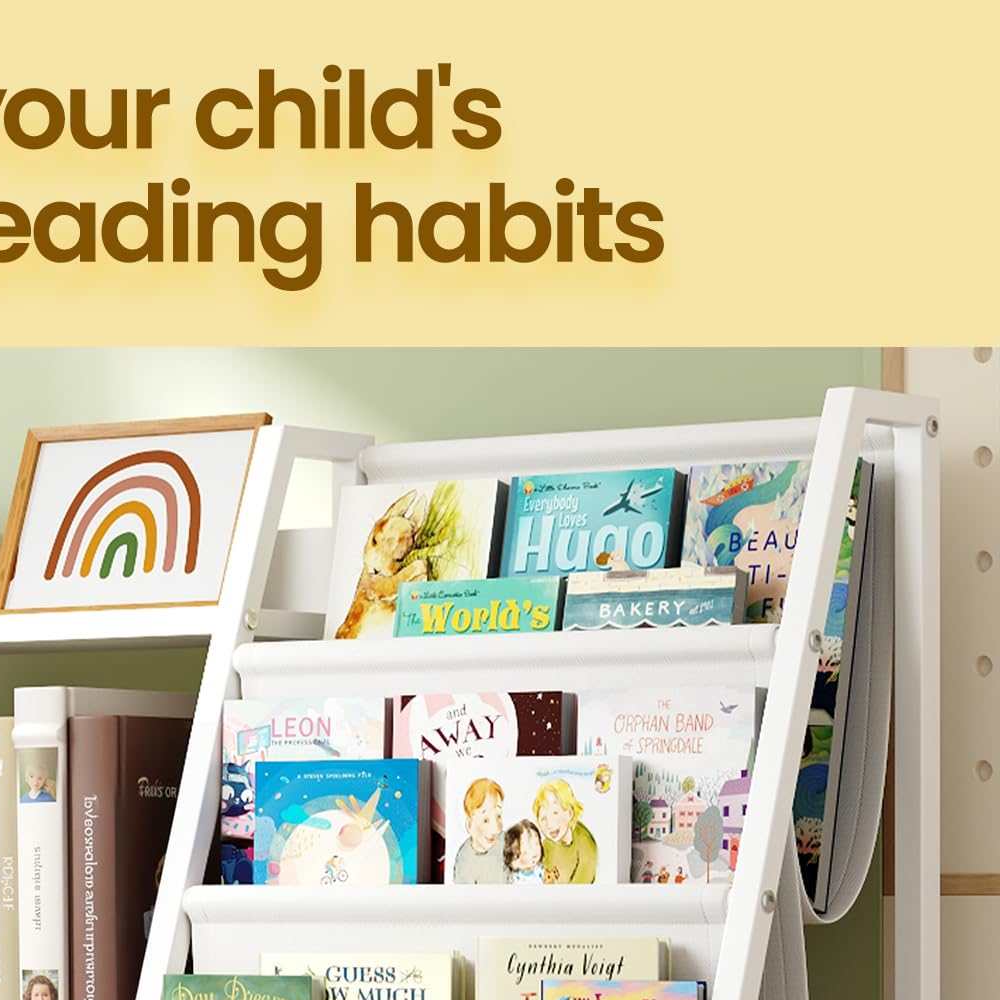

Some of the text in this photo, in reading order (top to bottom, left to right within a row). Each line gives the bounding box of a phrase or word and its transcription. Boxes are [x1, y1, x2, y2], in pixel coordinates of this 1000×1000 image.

[523, 494, 580, 514] Everybody
[558, 512, 588, 529] Loves
[729, 529, 799, 552] BEAU
[420, 599, 551, 634] World's
[599, 600, 686, 618] BAKERY
[446, 704, 467, 721] and
[271, 716, 332, 738] LEON
[614, 713, 714, 734] ORPHAN BAND
[421, 714, 502, 760] AWAY
[637, 736, 704, 754] SPRINGDALE
[326, 966, 397, 983] GUESS
[507, 953, 624, 985] Cynthia Voigt
